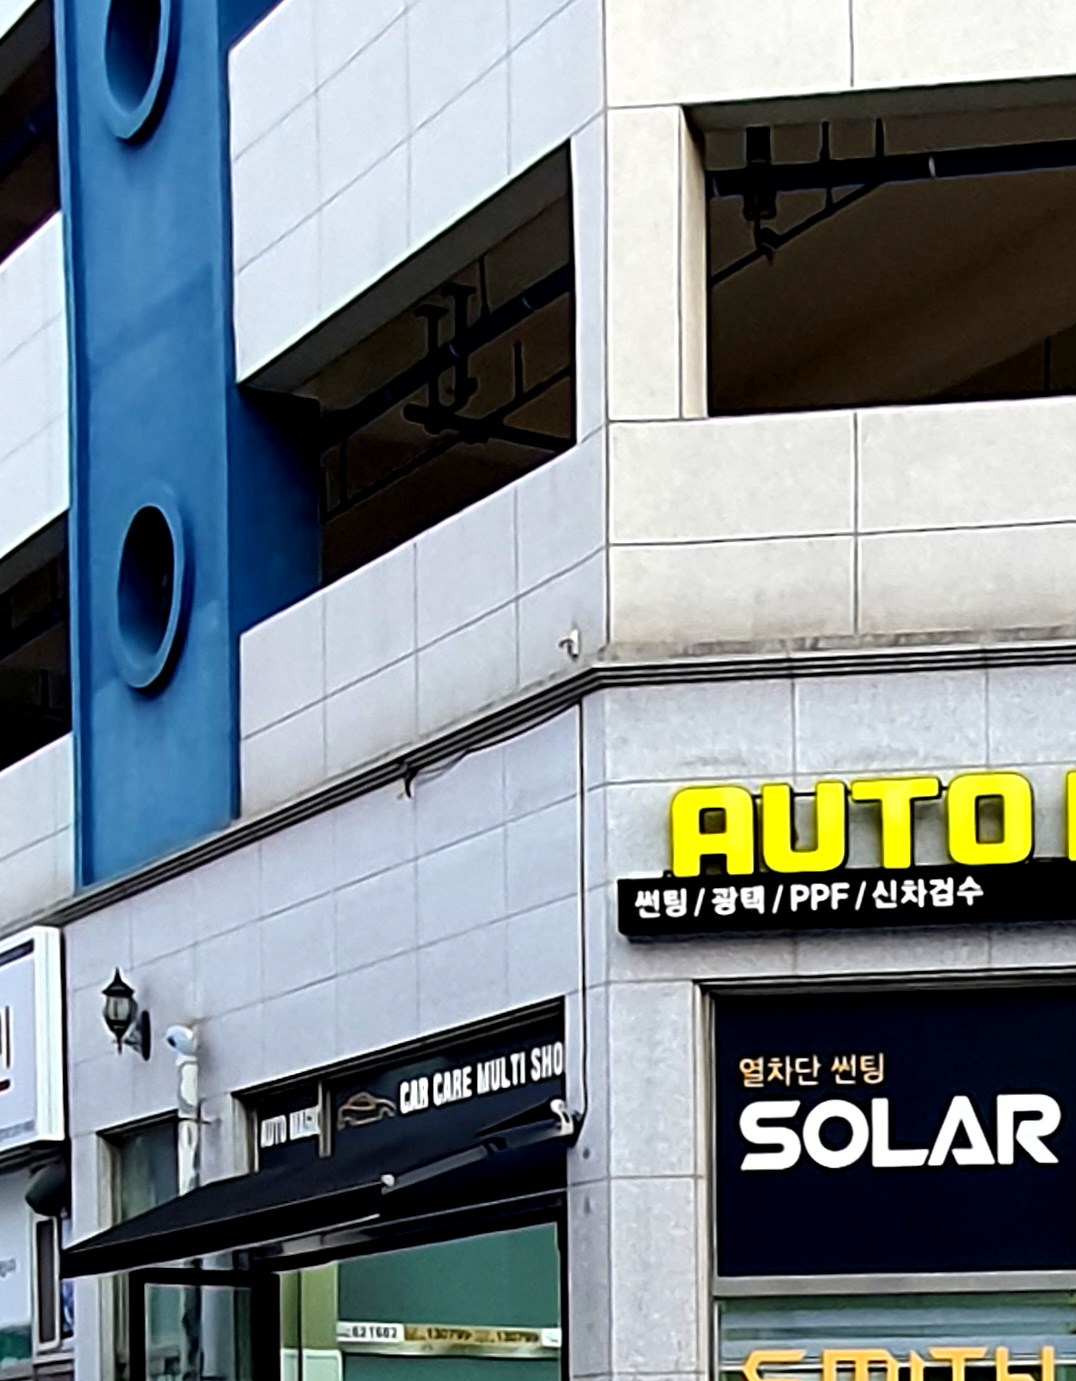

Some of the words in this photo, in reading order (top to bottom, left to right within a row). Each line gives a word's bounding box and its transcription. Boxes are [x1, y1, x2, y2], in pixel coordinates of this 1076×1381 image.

[669, 771, 1033, 877] AUTO
[791, 882, 850, 912] PPF
[872, 876, 984, 909] 신차검수
[400, 1074, 429, 1115] CAR
[433, 1065, 473, 1106] CARE
[477, 1052, 526, 1096] MULTI
[739, 1054, 822, 1087] 열차단
[830, 1052, 884, 1085] 썬팅
[739, 1094, 1061, 1171] SOLAR
